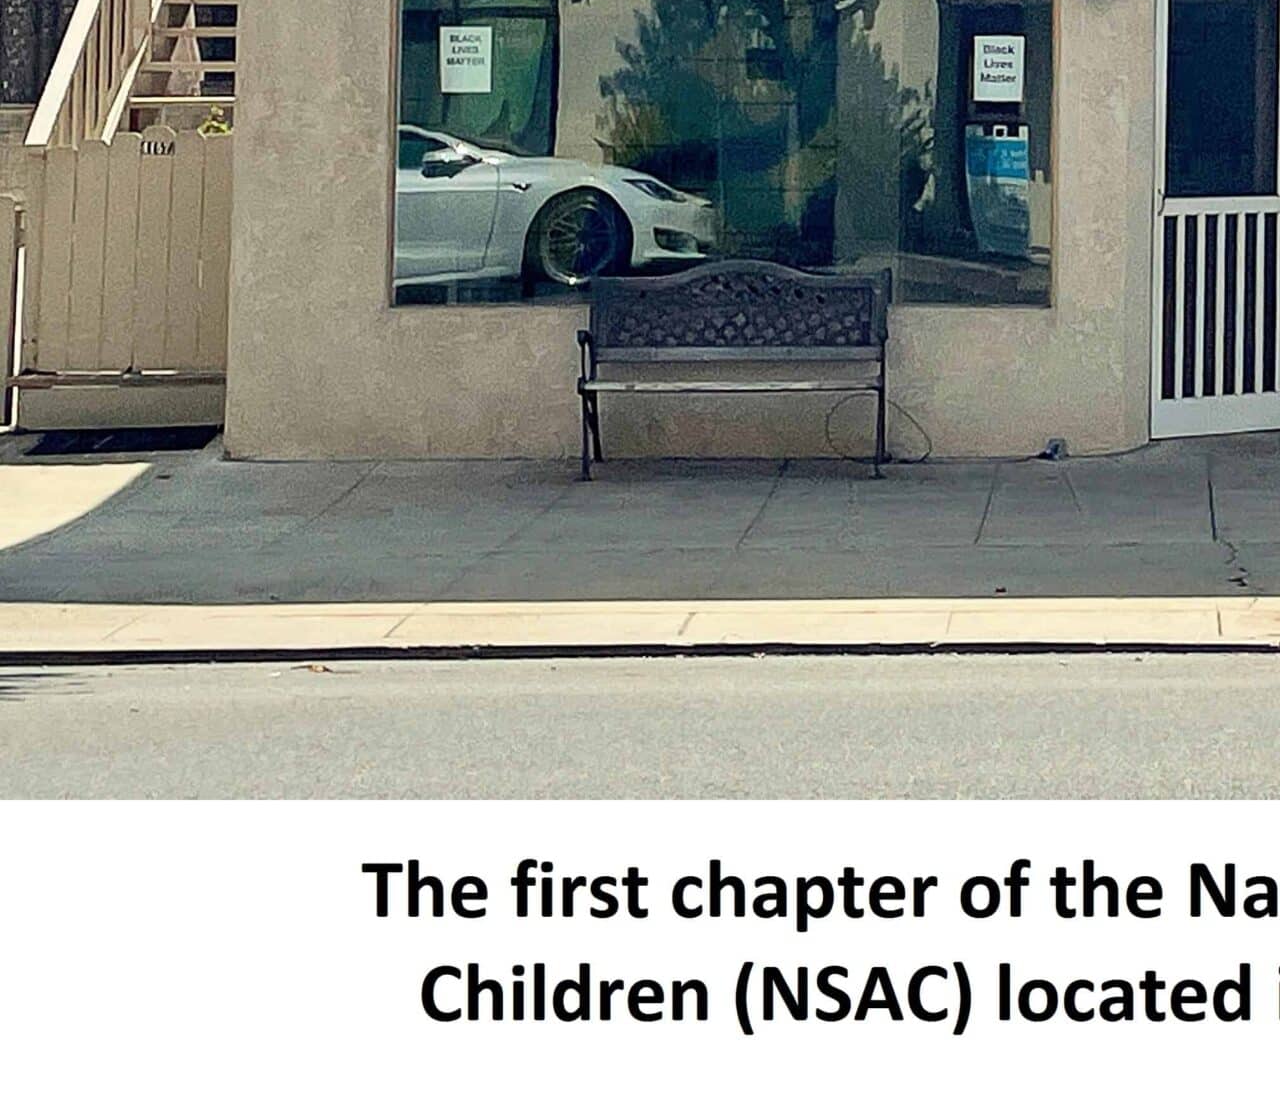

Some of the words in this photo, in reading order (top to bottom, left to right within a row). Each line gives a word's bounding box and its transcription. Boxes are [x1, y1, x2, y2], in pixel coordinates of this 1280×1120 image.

[983, 44, 1015, 55] Black
[983, 58, 1014, 69] Lives
[980, 72, 1016, 83] Matter
